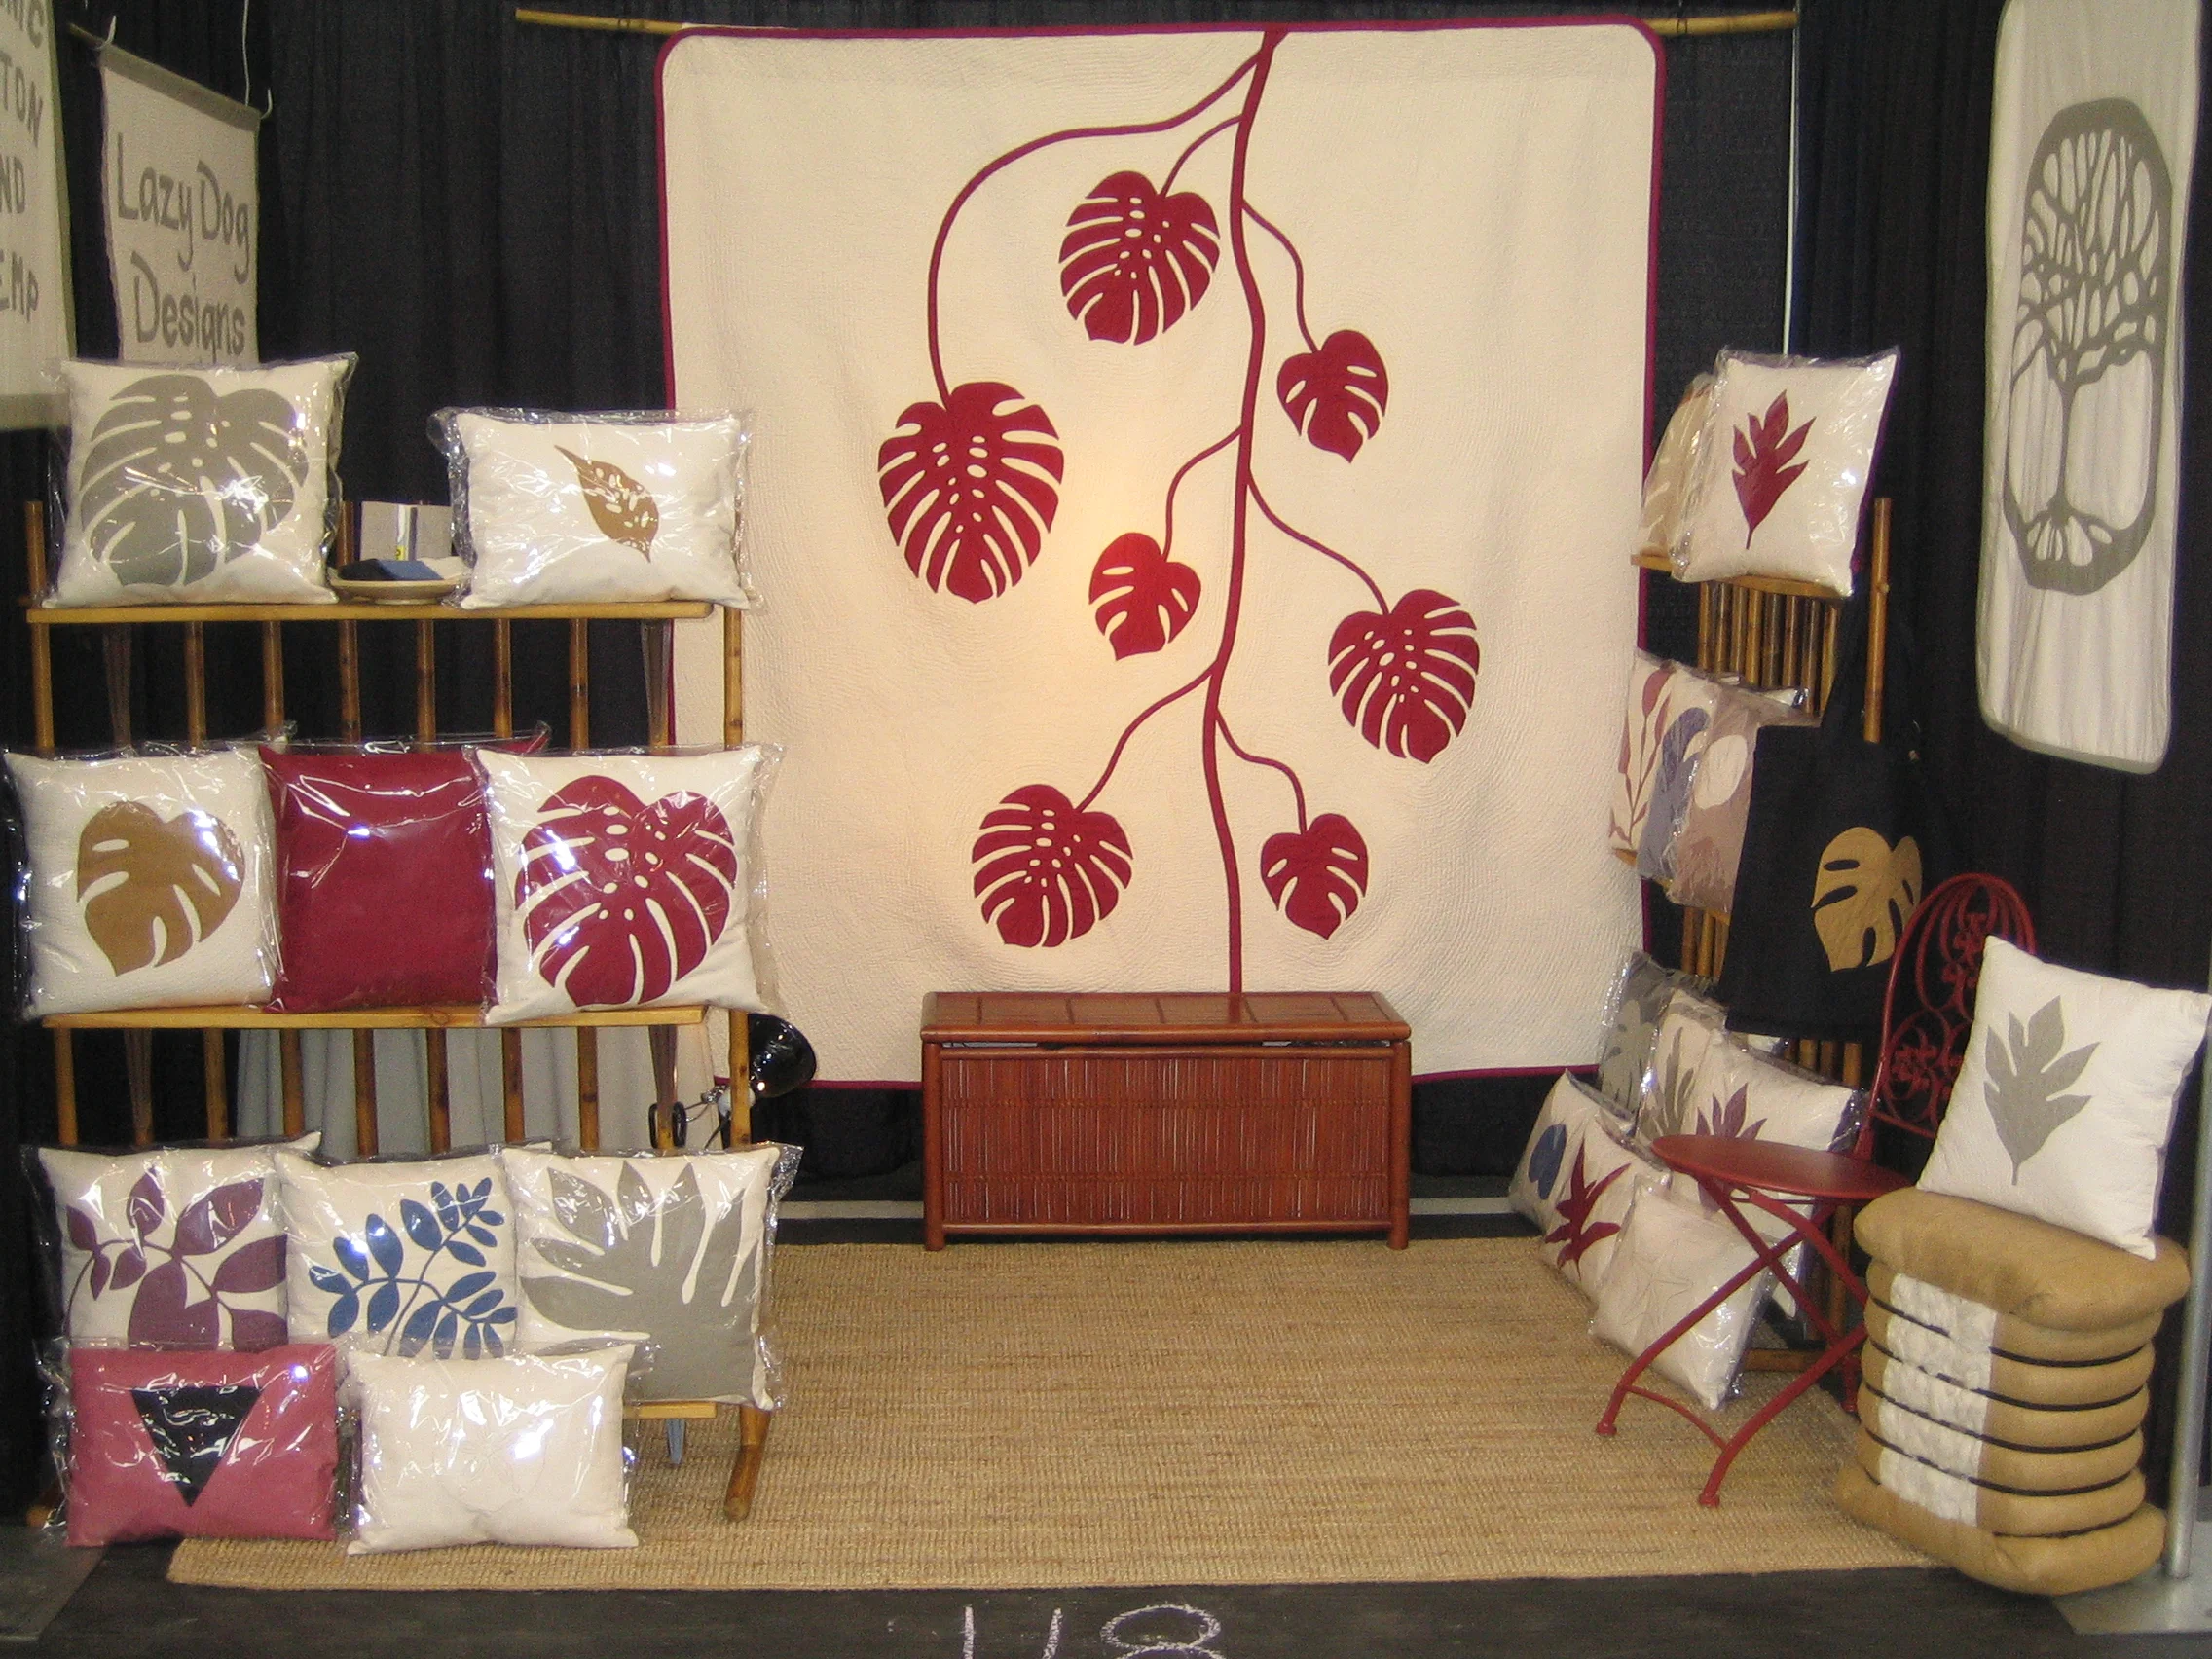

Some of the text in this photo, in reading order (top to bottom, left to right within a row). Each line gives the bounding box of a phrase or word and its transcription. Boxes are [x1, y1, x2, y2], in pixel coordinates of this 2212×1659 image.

[118, 132, 249, 284] Lazy Dog
[130, 250, 245, 363] Designs
